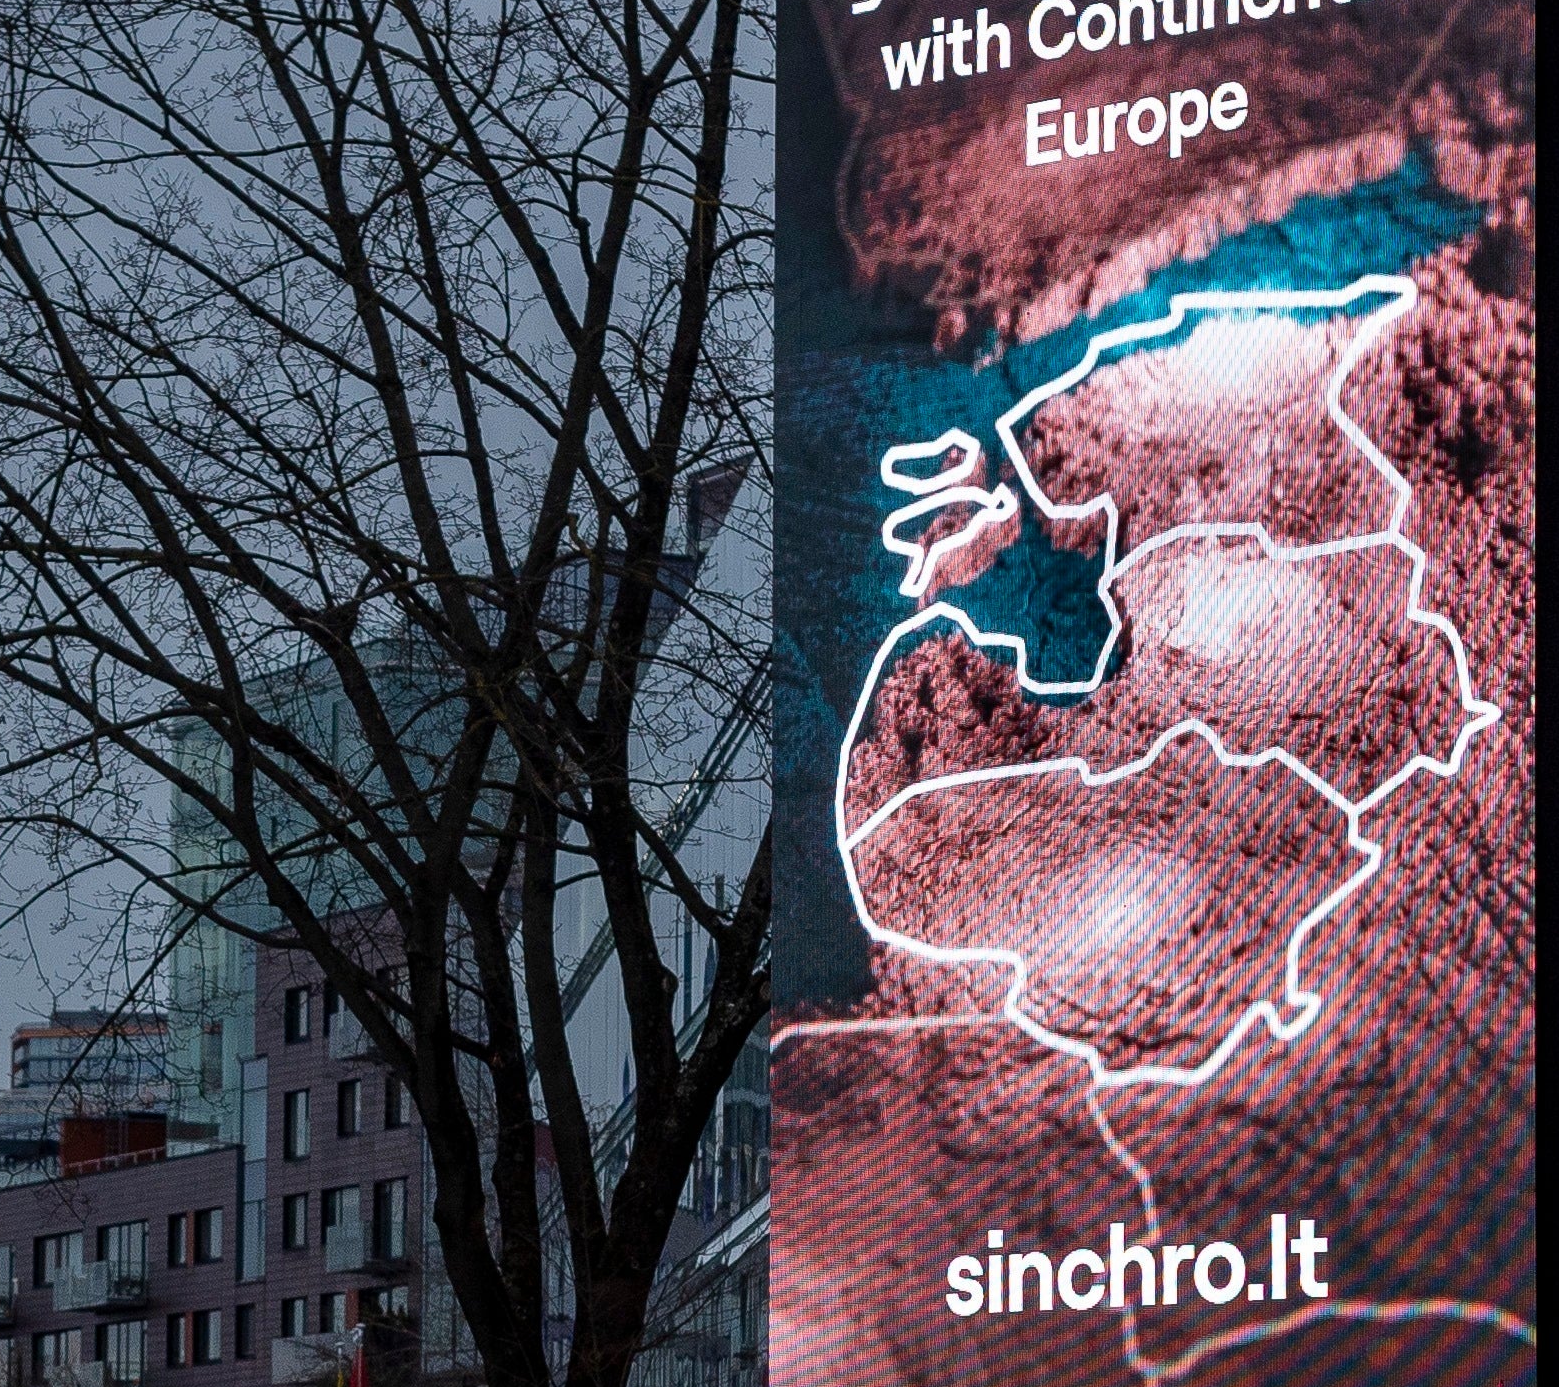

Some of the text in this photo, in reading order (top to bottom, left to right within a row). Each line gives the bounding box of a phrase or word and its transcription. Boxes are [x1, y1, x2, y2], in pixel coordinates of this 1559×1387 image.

[881, 8, 1010, 90] with
[1025, 82, 1248, 166] Europe
[945, 1213, 1329, 1316] sinchro.lt
